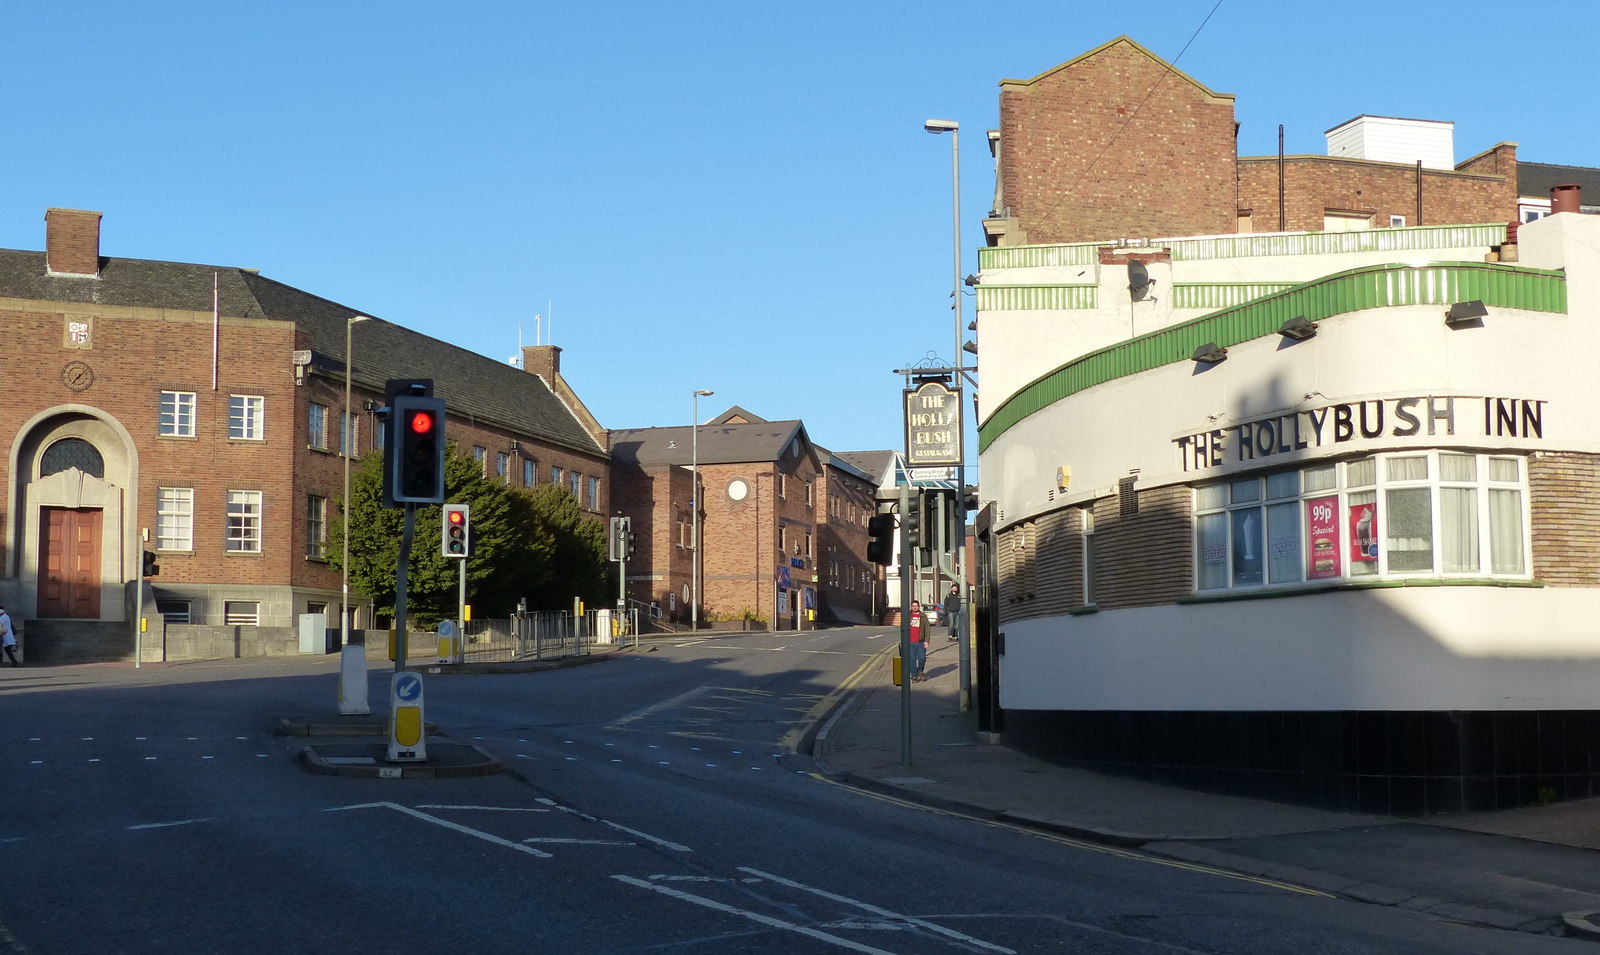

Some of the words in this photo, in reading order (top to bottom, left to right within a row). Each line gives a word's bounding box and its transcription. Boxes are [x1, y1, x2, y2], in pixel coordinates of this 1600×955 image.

[921, 395, 945, 409] THE
[912, 412, 953, 427] HOLLY
[916, 431, 951, 445] BUSH
[1178, 430, 1222, 472] THE
[1238, 396, 1454, 462] HOLLYBUSH
[1485, 397, 1542, 439] INN
[1313, 505, 1332, 524] 99p
[1312, 525, 1335, 536] Special
